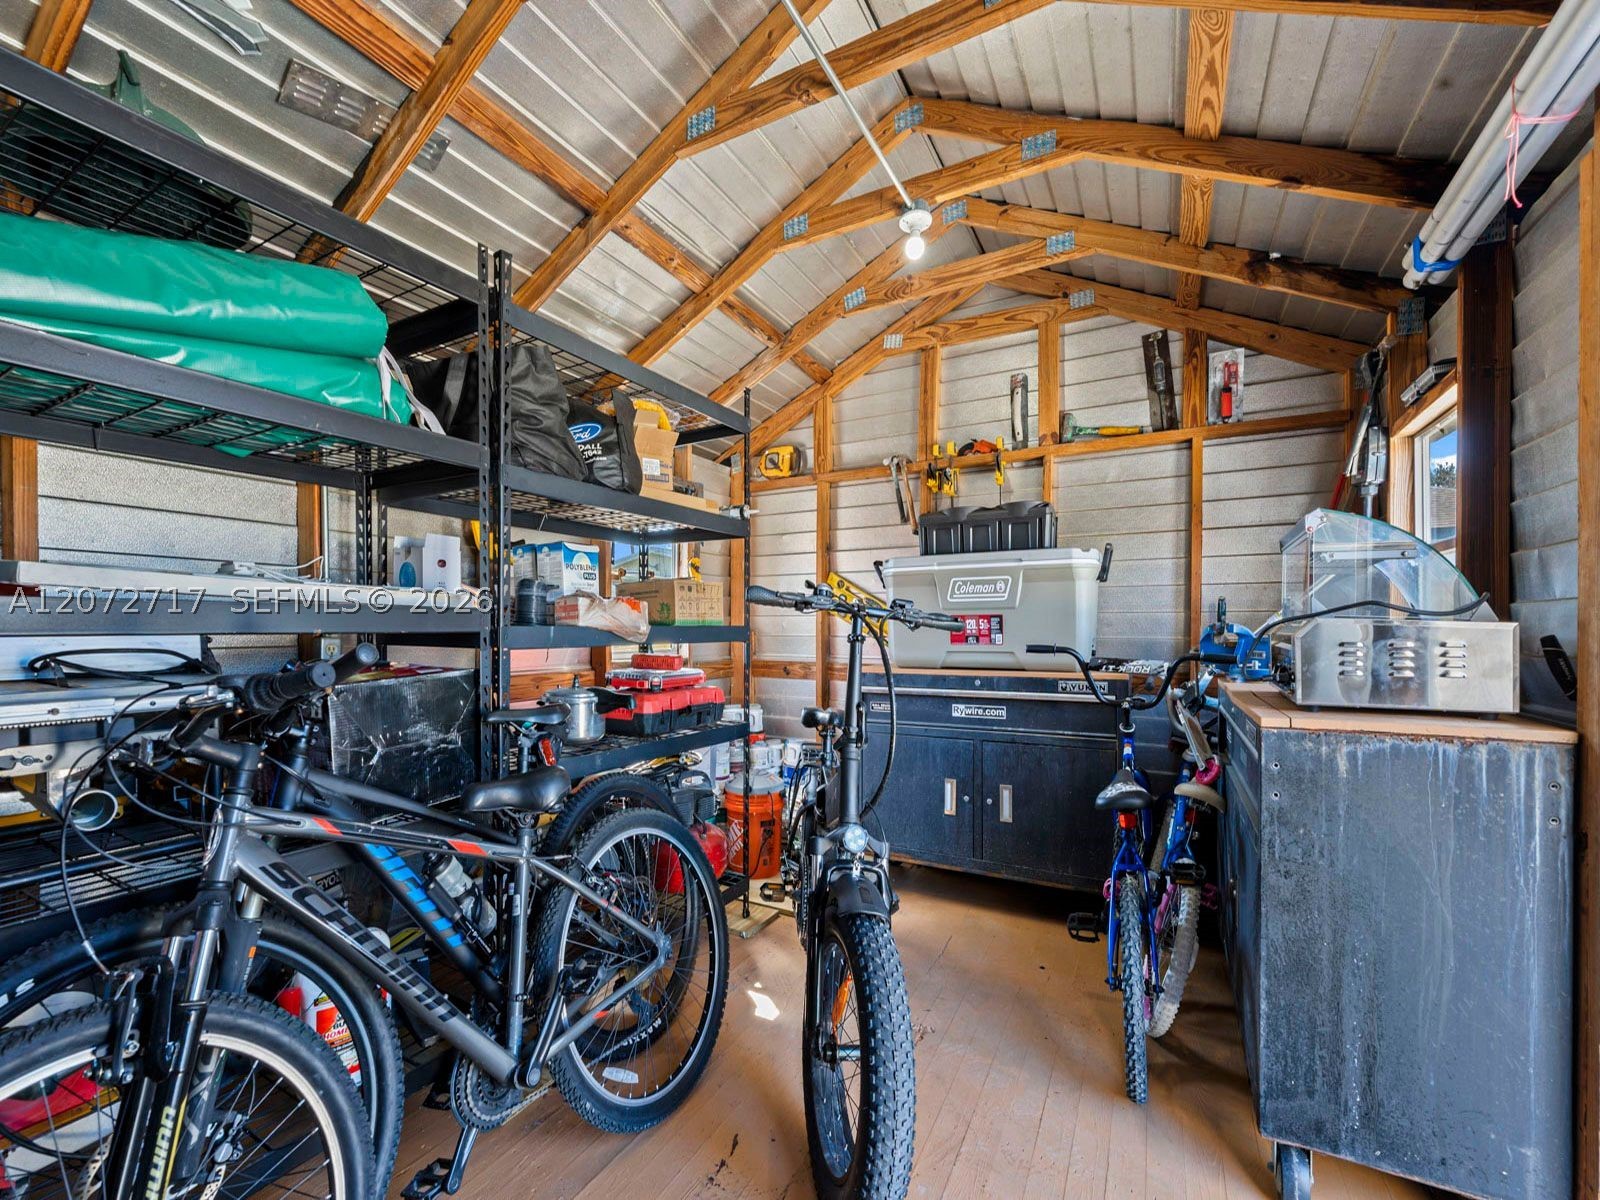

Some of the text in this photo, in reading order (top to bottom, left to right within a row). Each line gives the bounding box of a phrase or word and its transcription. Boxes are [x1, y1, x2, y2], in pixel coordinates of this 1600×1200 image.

[565, 563, 597, 571] POLYBLEND
[954, 581, 995, 594] Coleman
[1070, 683, 1106, 692] YUKN
[953, 706, 1006, 717] Rywire.com
